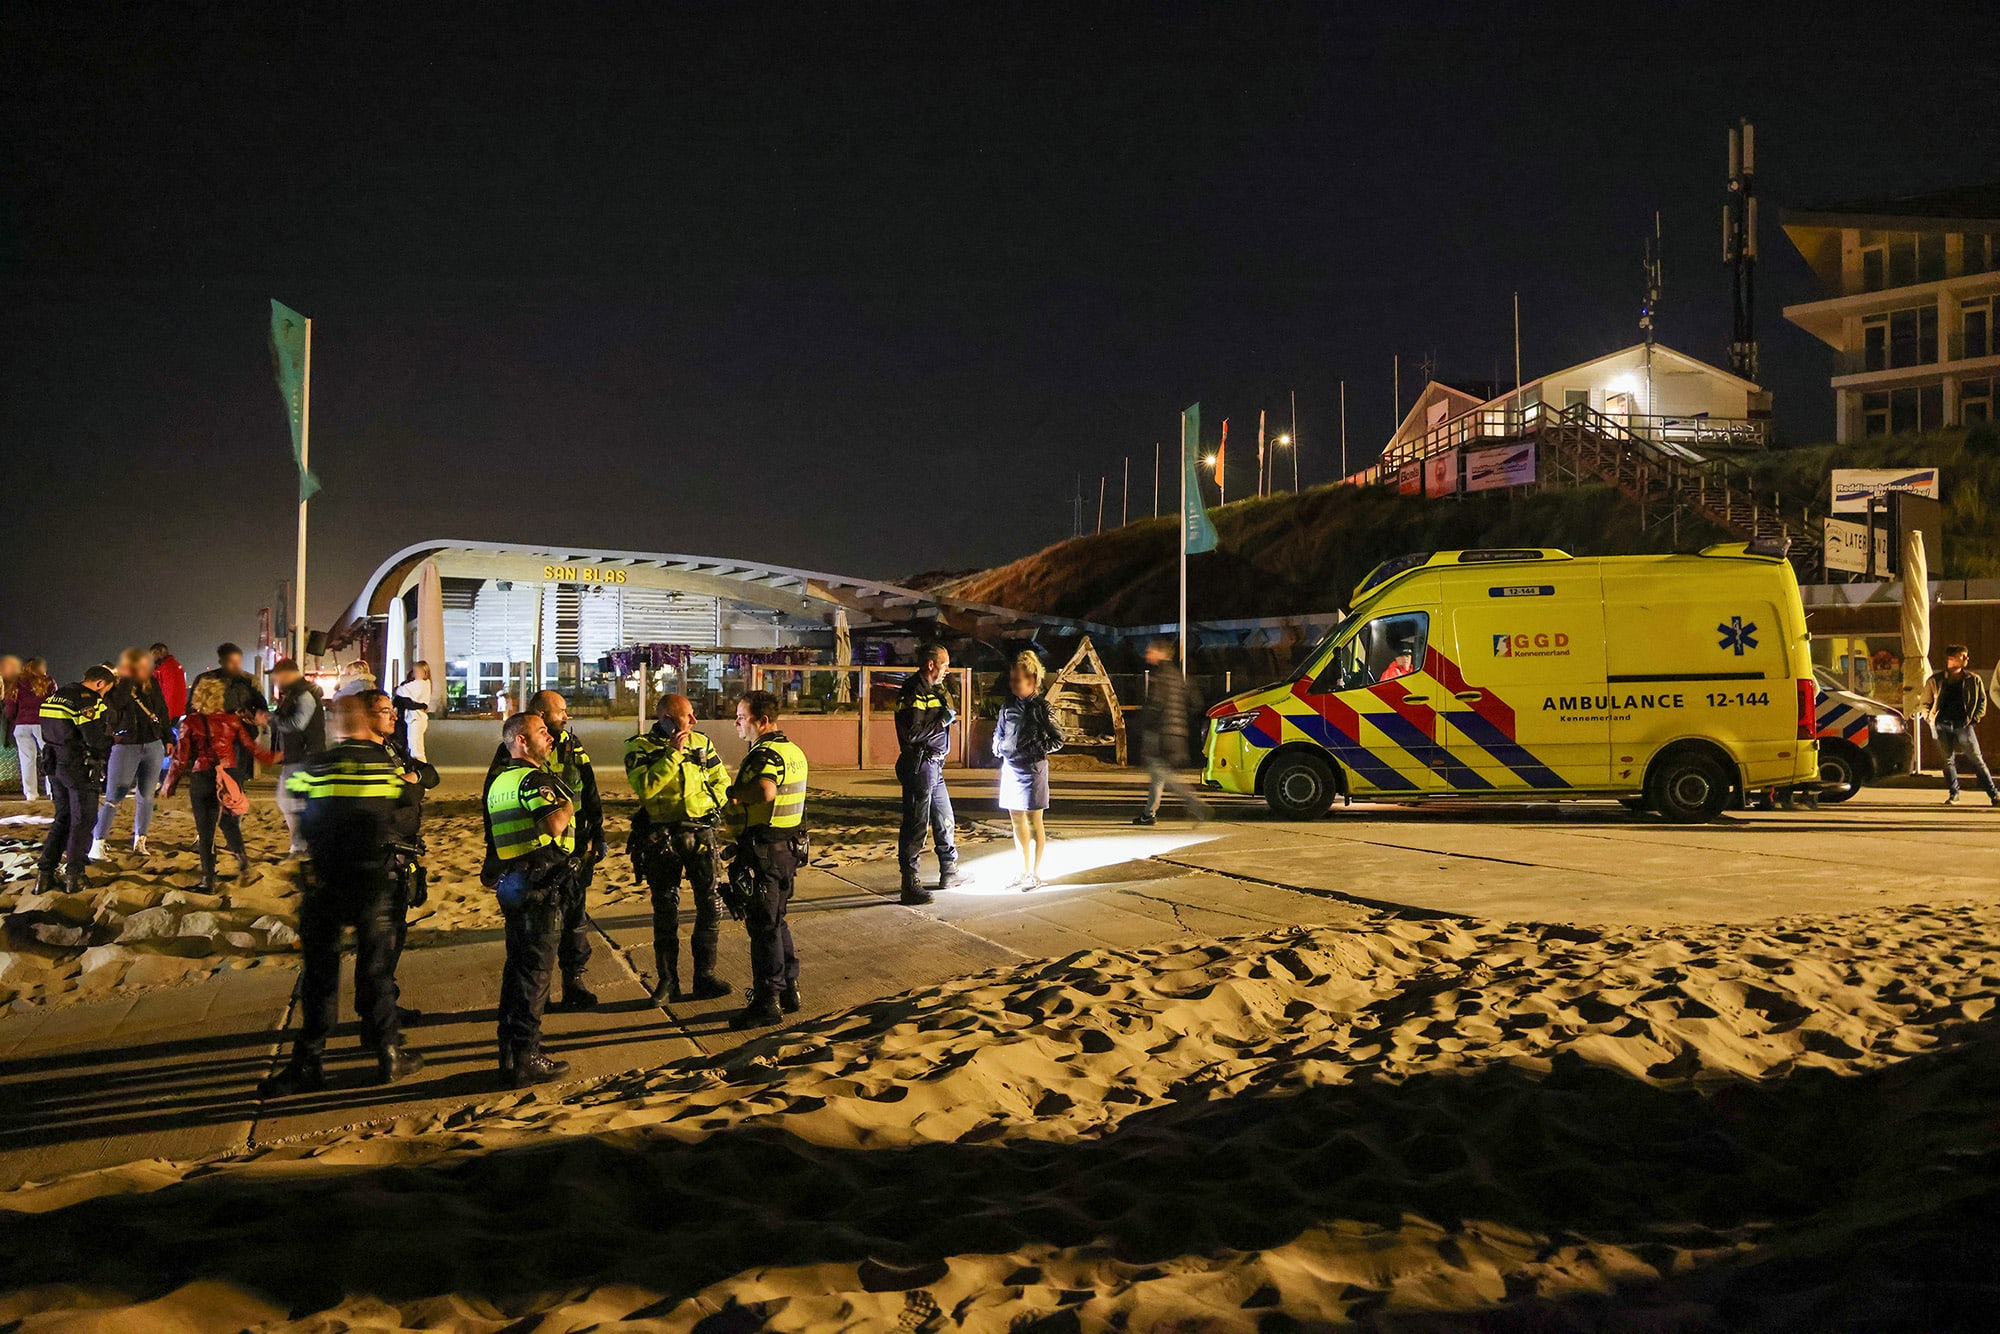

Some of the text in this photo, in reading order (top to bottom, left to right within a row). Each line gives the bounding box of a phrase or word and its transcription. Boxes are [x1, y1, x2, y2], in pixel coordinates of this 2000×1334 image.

[543, 565, 627, 583] SAN BLAS
[1542, 692, 1770, 711] AMBULANCE 12-144
[1560, 714, 1631, 722] Kennemerland
